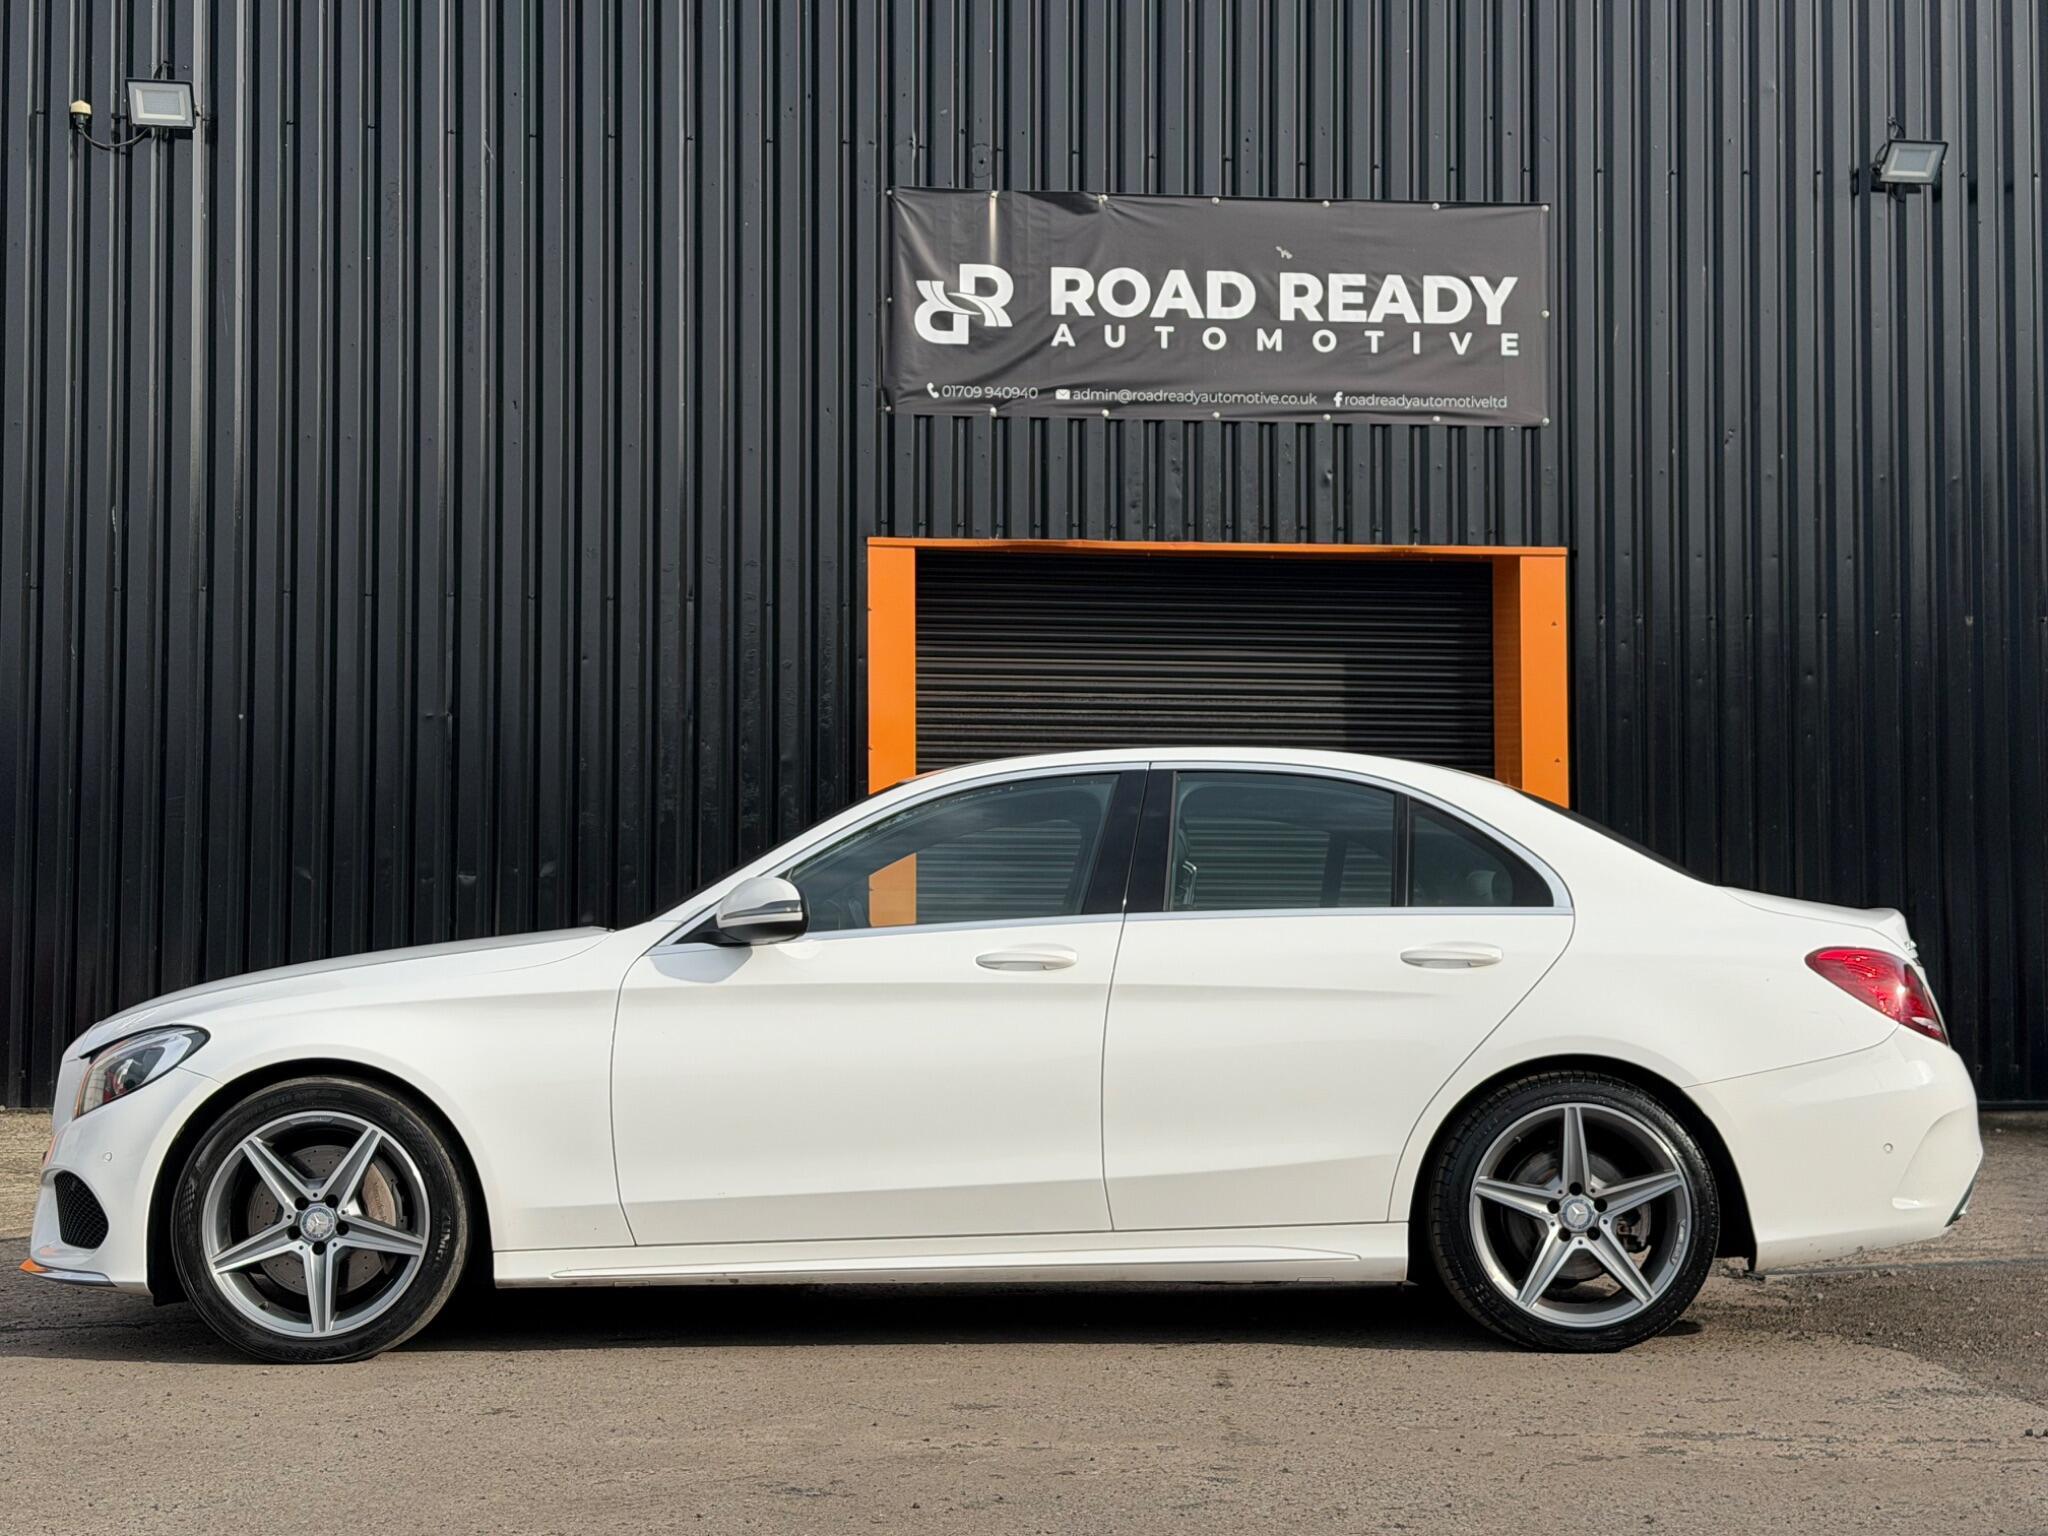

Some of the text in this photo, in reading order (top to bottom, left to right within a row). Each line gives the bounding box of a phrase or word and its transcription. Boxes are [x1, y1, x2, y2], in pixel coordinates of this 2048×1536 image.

[1050, 266, 1519, 325] ROAD READY
[1050, 323, 1520, 356] AUTOMOTIVE
[942, 384, 1038, 400] 01709 940940
[1072, 388, 1318, 406] admin@roadreadyautomotive.co.uk
[1345, 394, 1508, 410] roadreadyautomotiveltd
